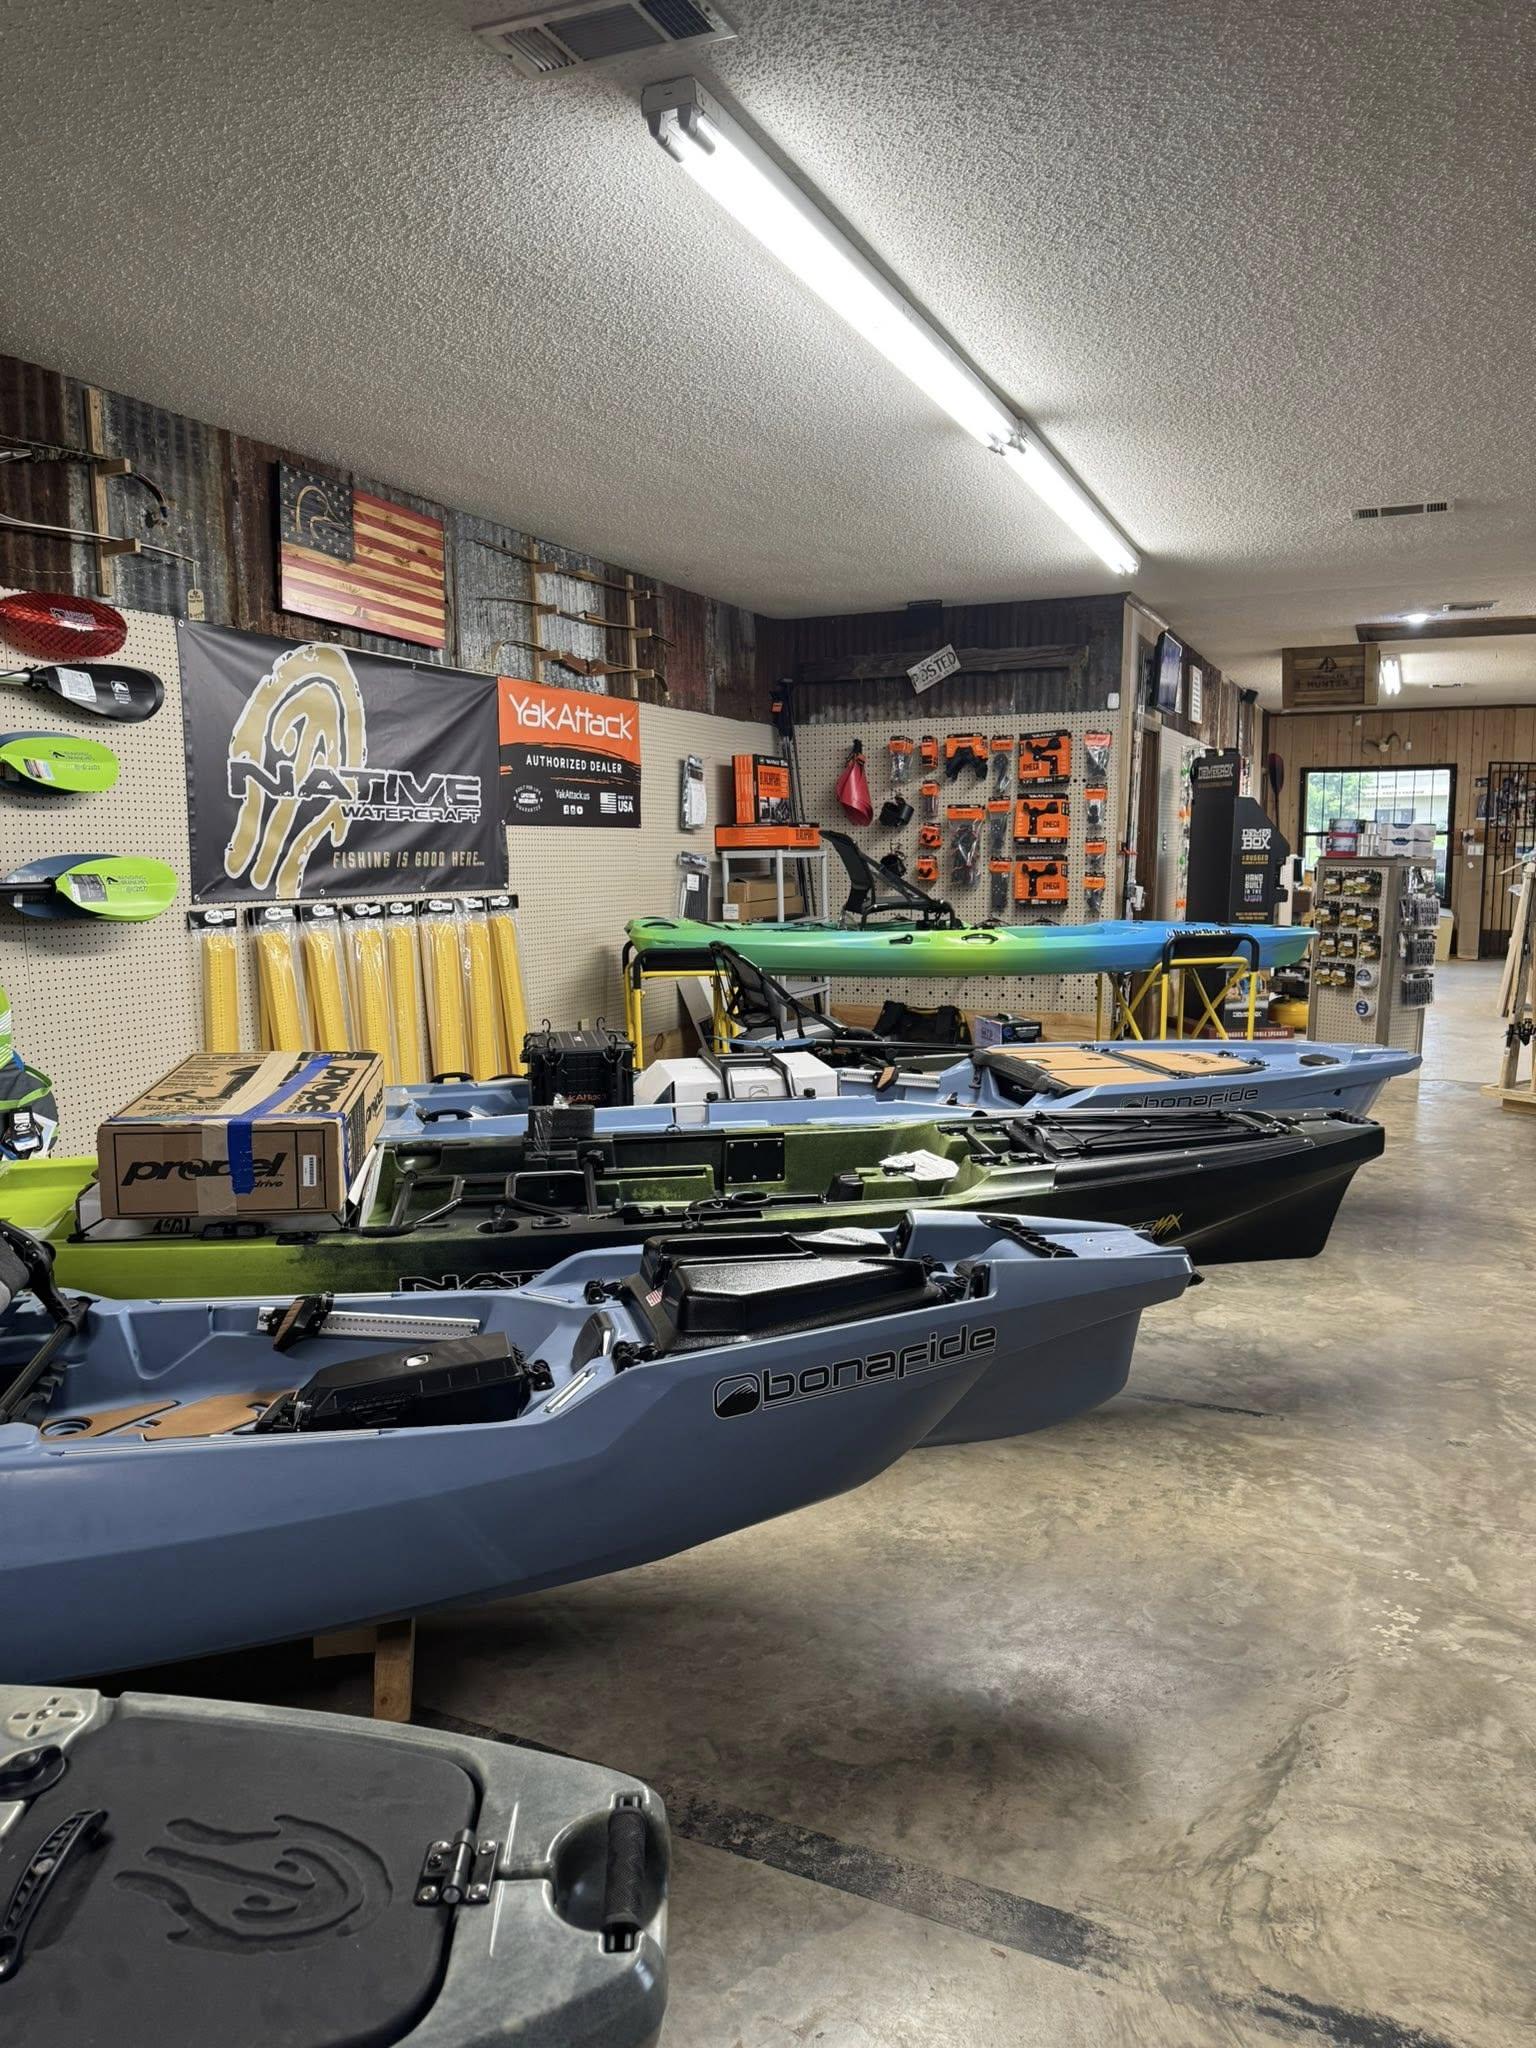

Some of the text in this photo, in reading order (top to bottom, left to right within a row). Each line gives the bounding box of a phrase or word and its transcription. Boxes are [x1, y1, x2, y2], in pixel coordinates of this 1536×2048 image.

[910, 651, 957, 688] POSTED
[508, 693, 633, 741] YakAttack
[526, 754, 622, 774] AUTHORIZED DEALER
[227, 760, 482, 809] NATIVE
[340, 805, 481, 824] WATERCRAFT
[618, 800, 634, 813] USA
[333, 851, 391, 869] FISHING
[397, 851, 408, 868] IS
[415, 850, 445, 867] GOOD
[1143, 1087, 1259, 1108] bonafide
[763, 1324, 998, 1404] bonafide
